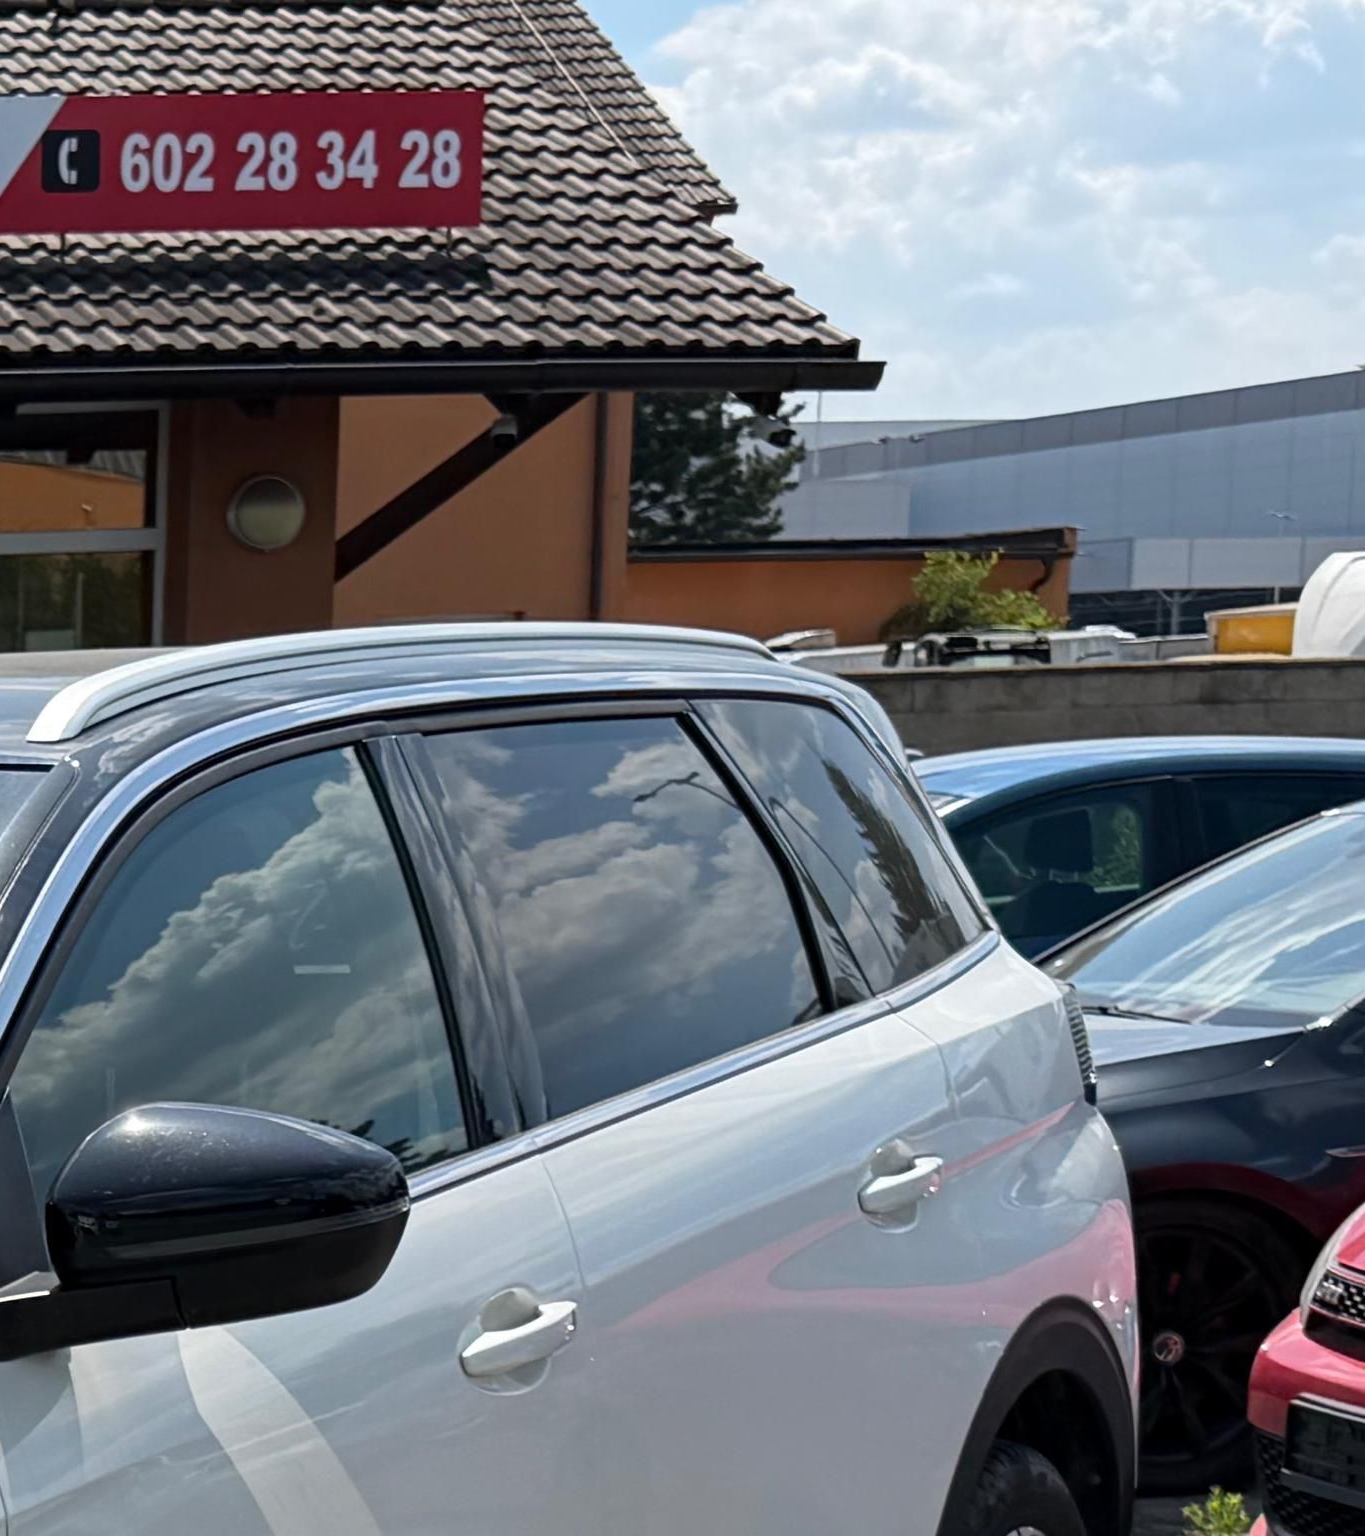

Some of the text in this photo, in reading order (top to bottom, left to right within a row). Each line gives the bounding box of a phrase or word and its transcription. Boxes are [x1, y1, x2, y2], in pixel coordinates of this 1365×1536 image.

[121, 132, 215, 193] 602
[235, 131, 298, 192] 28
[316, 129, 379, 189] 34
[398, 128, 462, 188] 28
